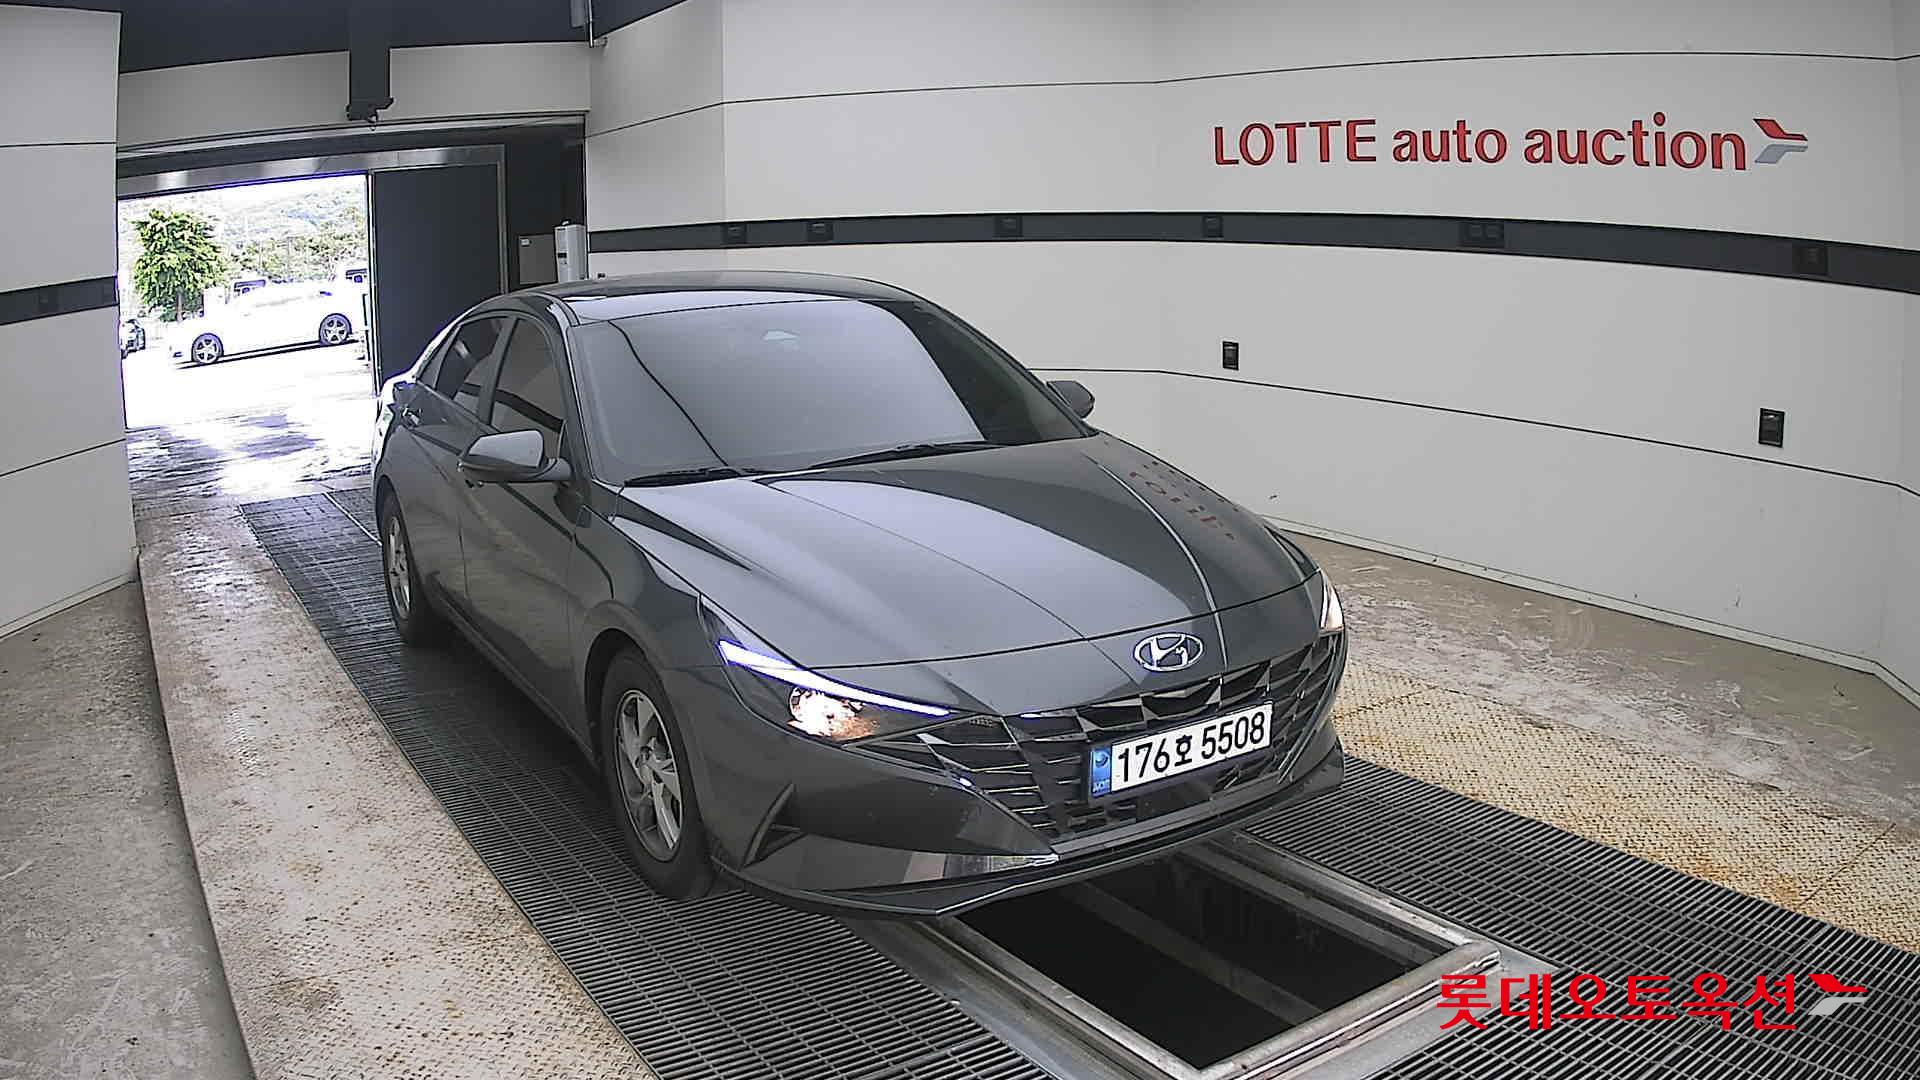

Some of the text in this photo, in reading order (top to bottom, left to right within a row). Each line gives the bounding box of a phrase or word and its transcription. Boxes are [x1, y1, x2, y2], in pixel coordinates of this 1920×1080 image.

[1214, 111, 1747, 171] LOTTE auto auction
[1201, 711, 1265, 761] 5508
